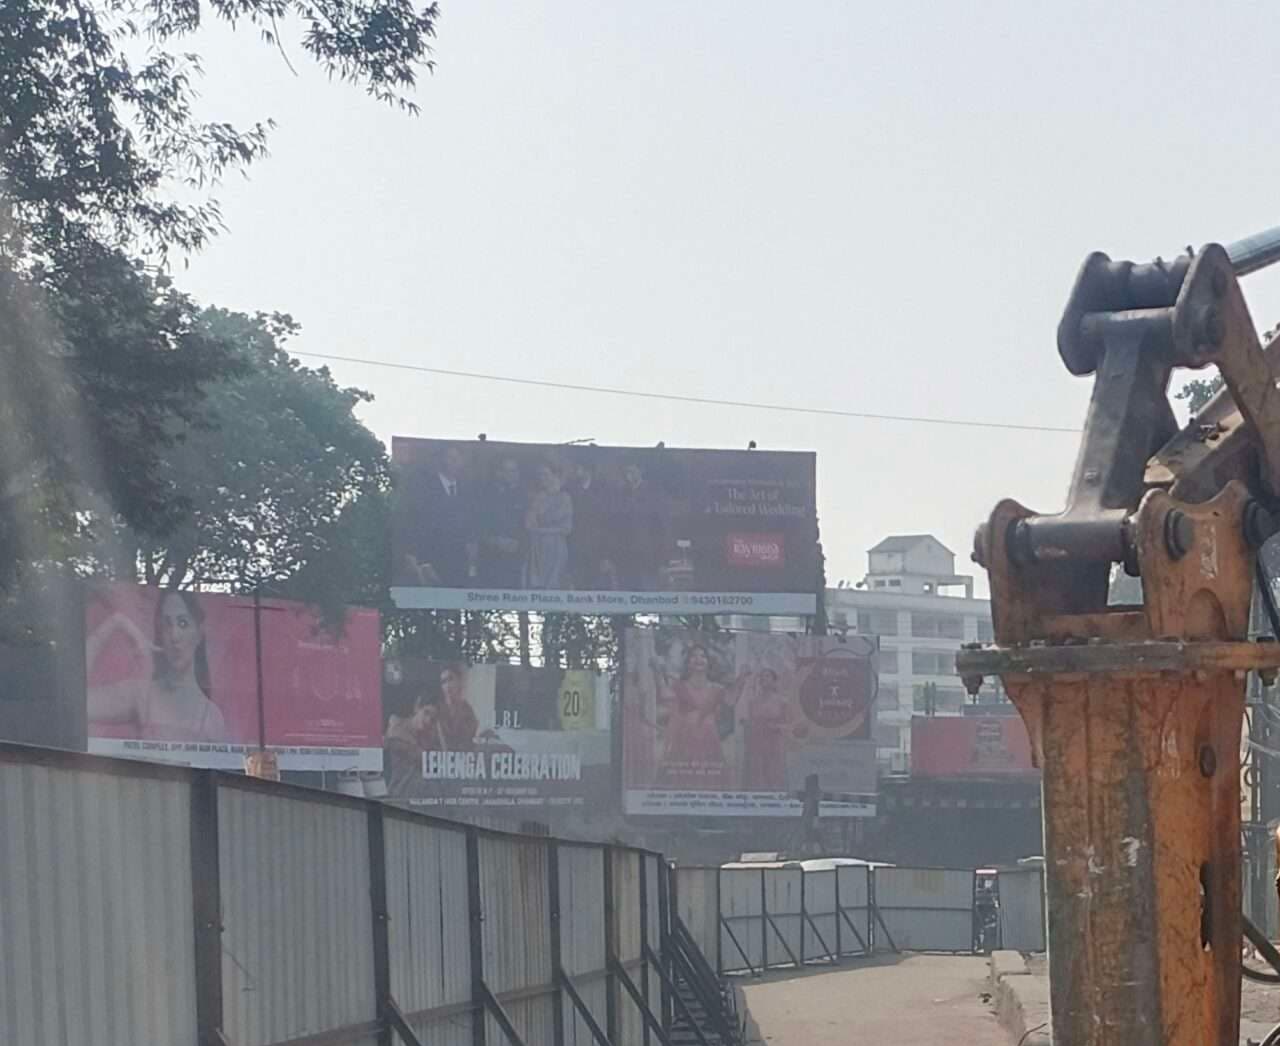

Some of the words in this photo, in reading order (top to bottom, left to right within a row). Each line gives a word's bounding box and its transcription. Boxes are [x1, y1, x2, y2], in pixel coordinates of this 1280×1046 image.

[466, 591, 500, 602] Shree
[502, 592, 528, 602] Ram
[566, 594, 594, 604] Bank
[630, 595, 679, 606] Dhanbad
[563, 690, 580, 717] 20
[421, 750, 487, 780] LEHENGA
[491, 752, 581, 781] CELEBRATION
